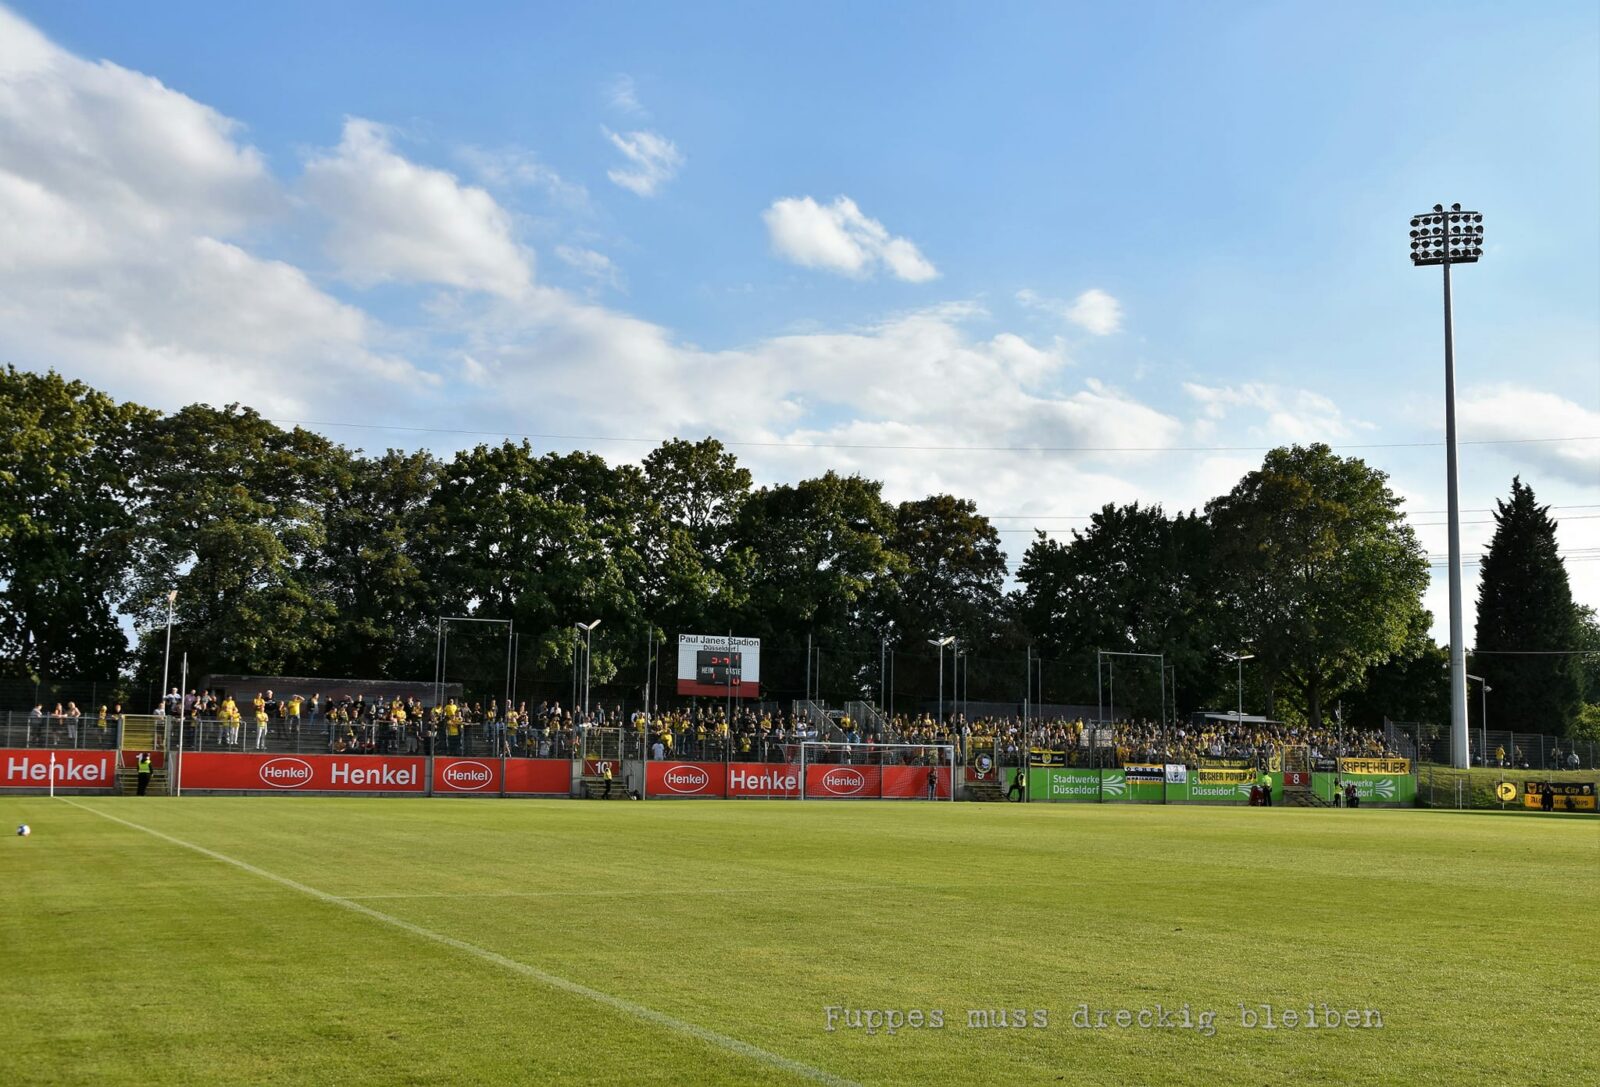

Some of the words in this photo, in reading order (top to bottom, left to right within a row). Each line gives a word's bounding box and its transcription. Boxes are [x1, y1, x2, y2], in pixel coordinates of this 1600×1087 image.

[680, 635, 698, 643] Paul
[700, 636, 726, 645] Janes
[728, 637, 759, 647] Stadion
[701, 666, 714, 674] HEIM
[7, 757, 107, 781] Henkel
[264, 767, 308, 778] Henkel
[595, 761, 608, 774] 10
[331, 763, 417, 785] Henkel
[447, 770, 488, 781] Henkel
[668, 774, 705, 785] Henkel
[1053, 774, 1100, 784] Stadtwerke
[1226, 772, 1247, 782] POWER
[1293, 773, 1300, 784] 8
[730, 770, 802, 790] Henkel
[826, 778, 861, 787] Henkel
[1053, 784, 1100, 795] Düsseldorf
[1192, 787, 1236, 797] Düsseldorf
